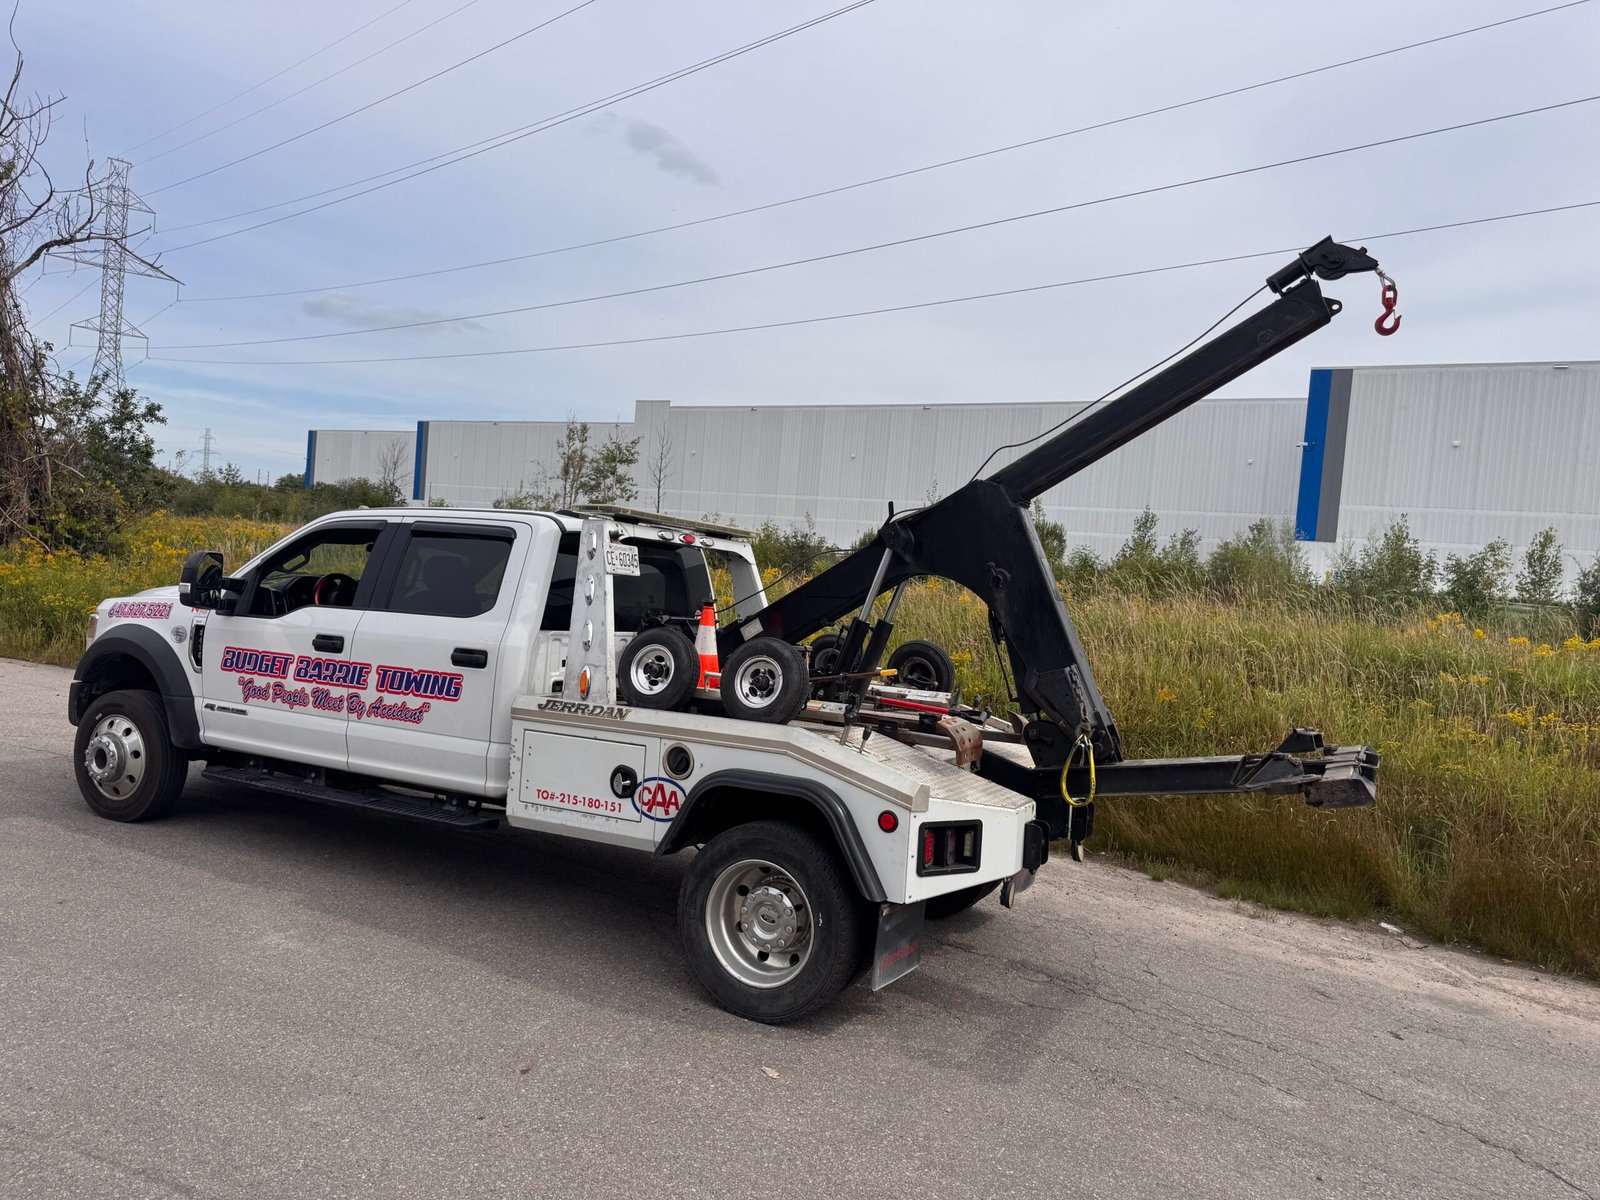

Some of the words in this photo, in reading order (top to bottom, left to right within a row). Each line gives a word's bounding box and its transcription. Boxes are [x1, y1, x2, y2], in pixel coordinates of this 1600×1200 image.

[605, 550, 616, 566] CE
[618, 552, 639, 569] 60345
[221, 646, 294, 679] BUDGET
[294, 656, 371, 690] BARRIE
[376, 665, 464, 702] TOWING
[272, 681, 309, 710] People
[311, 687, 343, 712] Meet
[346, 693, 366, 720] By
[536, 789, 622, 813] TO#-215-180-151
[638, 783, 681, 816] CAA
